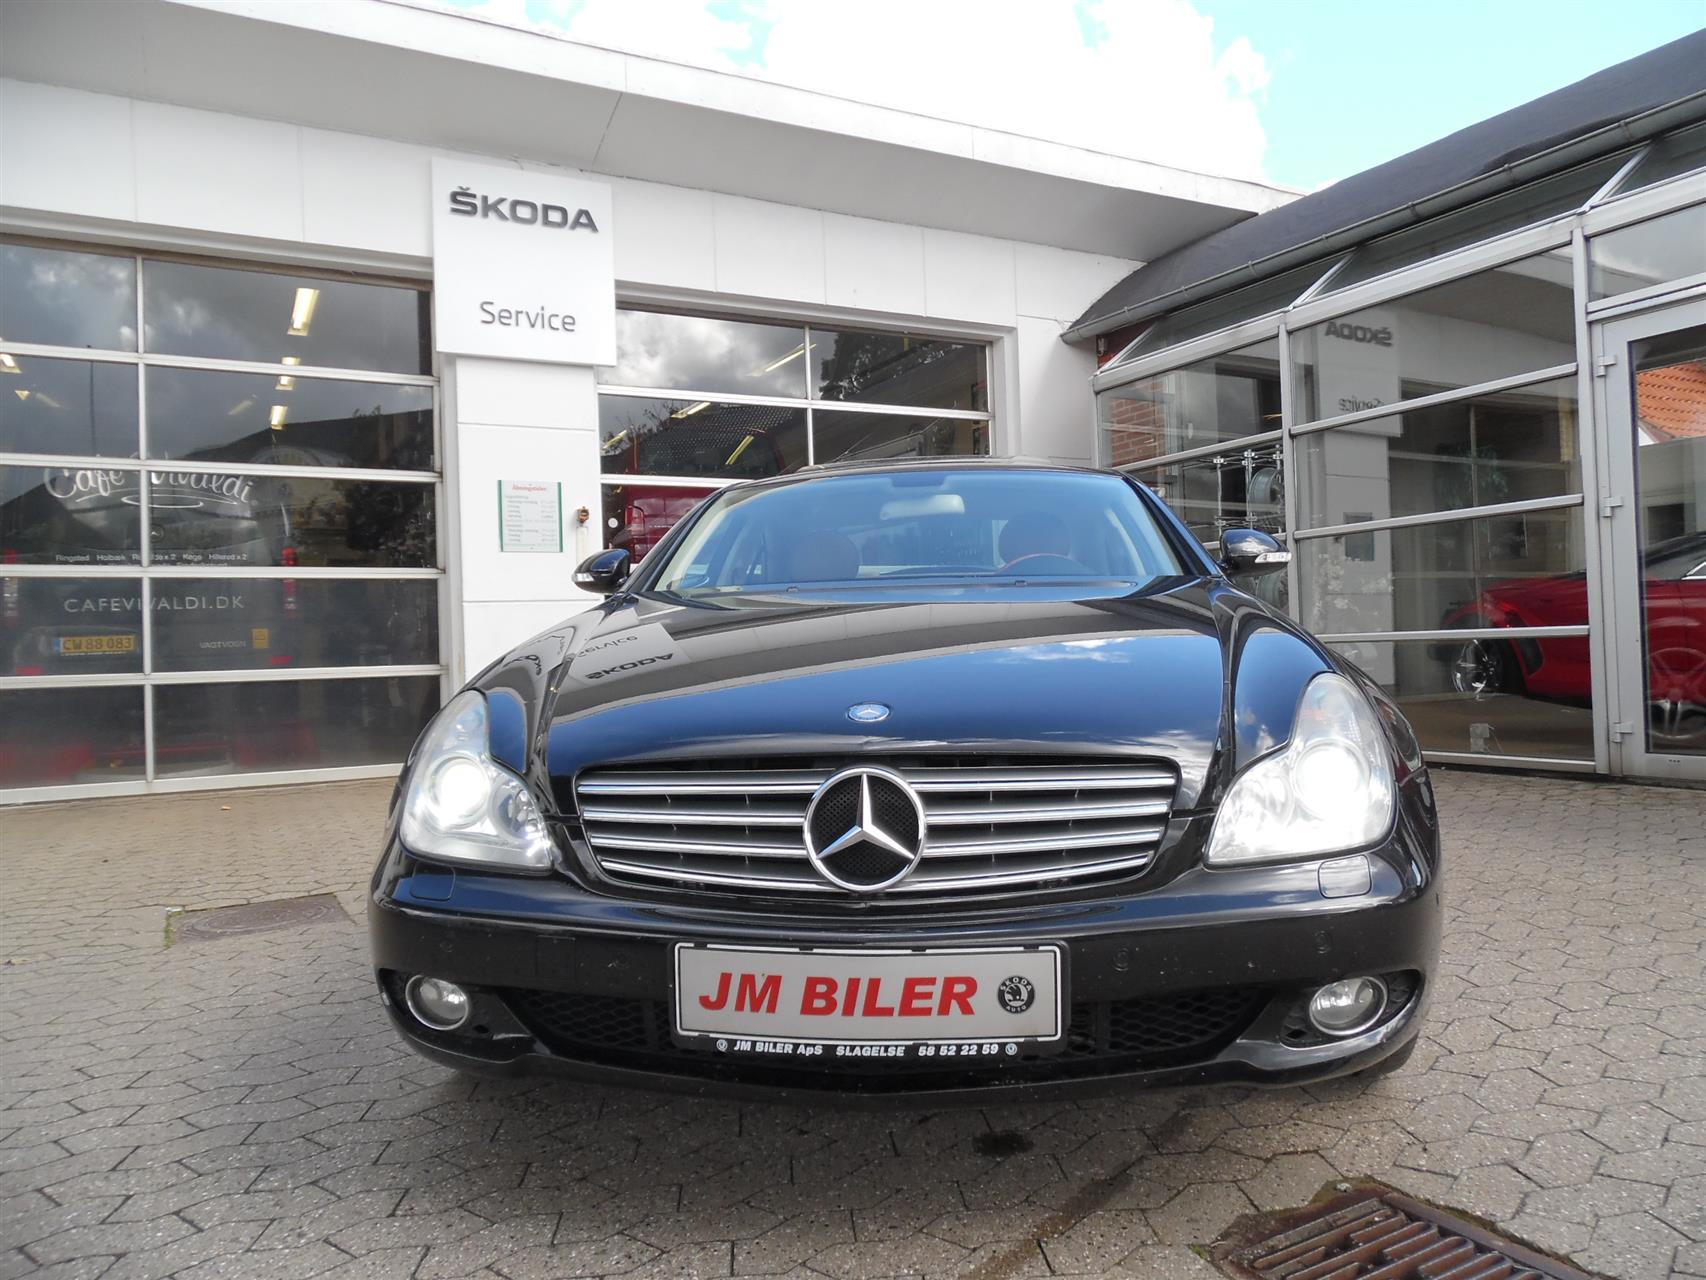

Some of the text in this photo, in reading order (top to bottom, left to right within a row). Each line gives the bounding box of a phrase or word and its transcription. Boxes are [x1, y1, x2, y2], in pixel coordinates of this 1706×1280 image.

[449, 185, 599, 233] ŠKODA
[479, 300, 577, 333] Service
[697, 971, 979, 1018] JM BILER
[733, 1040, 752, 1052] JM
[755, 1041, 794, 1055] BILER
[796, 1044, 824, 1057] ApS
[835, 1045, 906, 1057] SLAGELSE
[939, 1045, 957, 1056] 52
[960, 1044, 978, 1056] 22
[981, 1043, 999, 1055] 59
